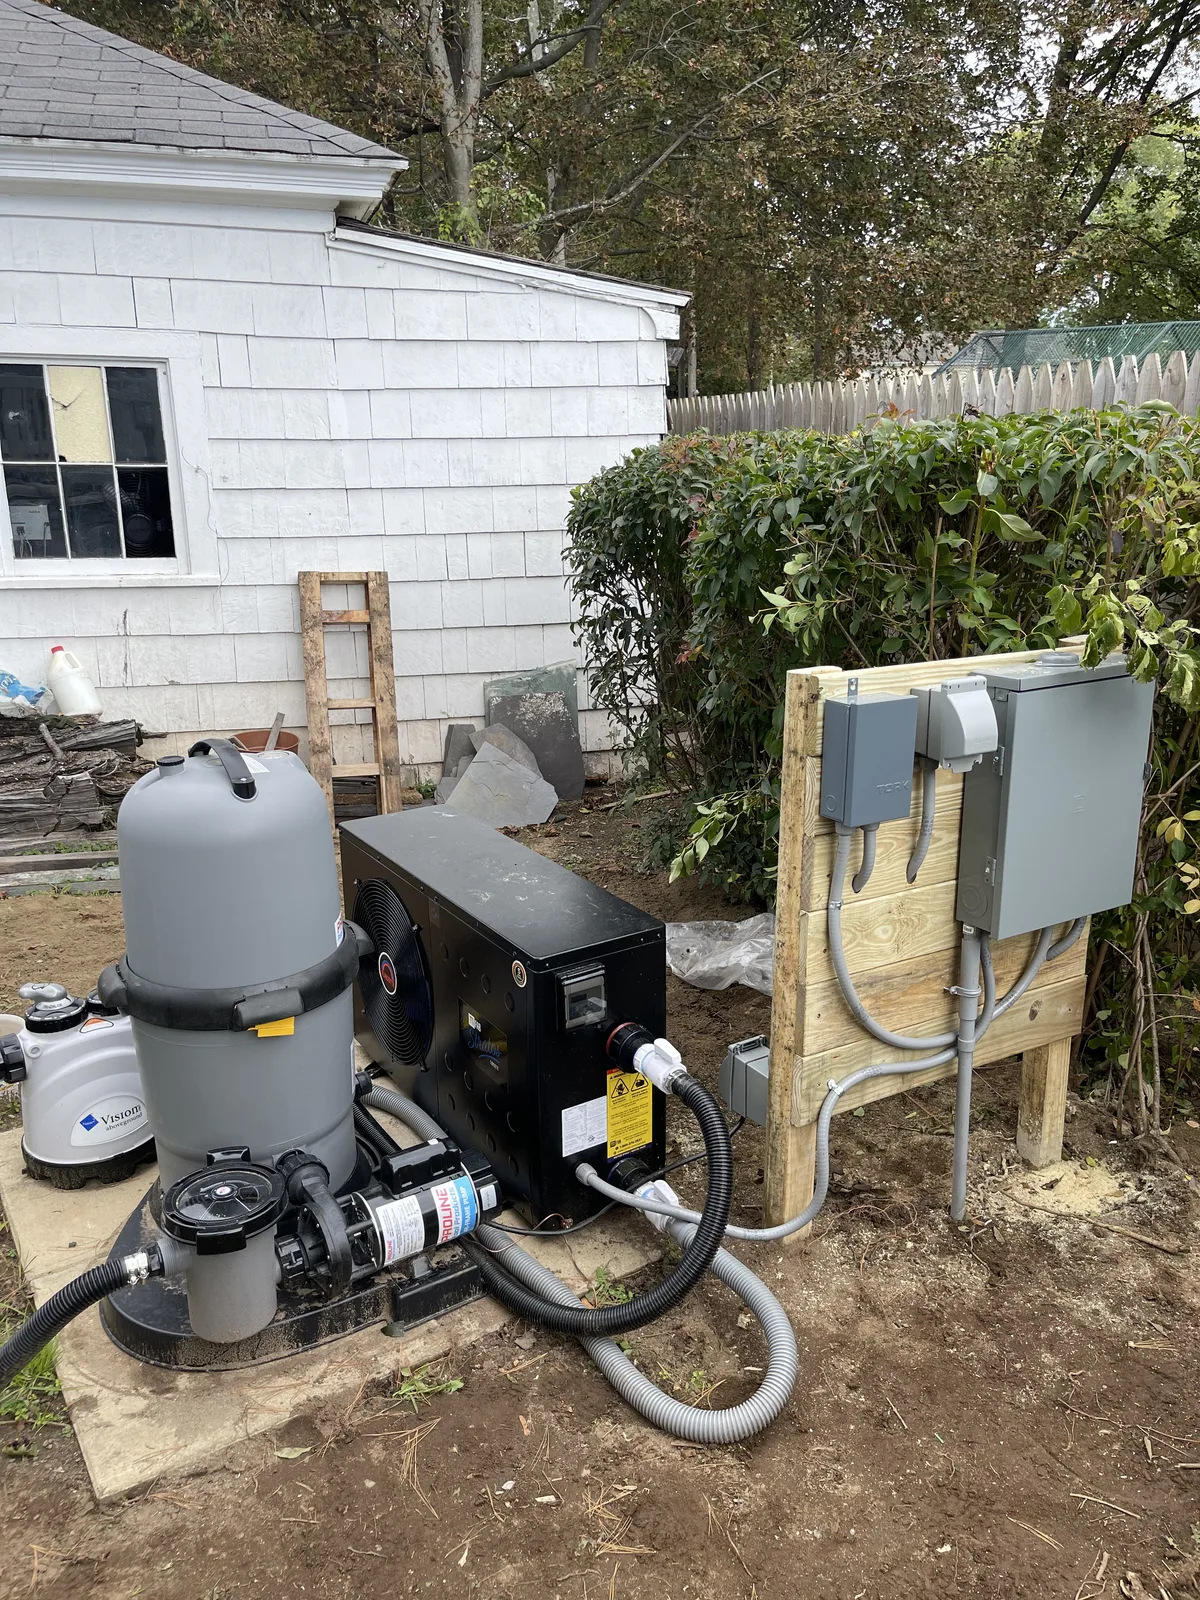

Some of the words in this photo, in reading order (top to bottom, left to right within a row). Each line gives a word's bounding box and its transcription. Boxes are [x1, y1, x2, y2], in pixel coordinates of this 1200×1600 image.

[876, 780, 909, 795] TORK
[106, 1112, 143, 1131] aboveground
[460, 1186, 469, 1205] PUMP
[435, 1188, 453, 1242] PROLINE
[450, 1187, 461, 1226] Products
